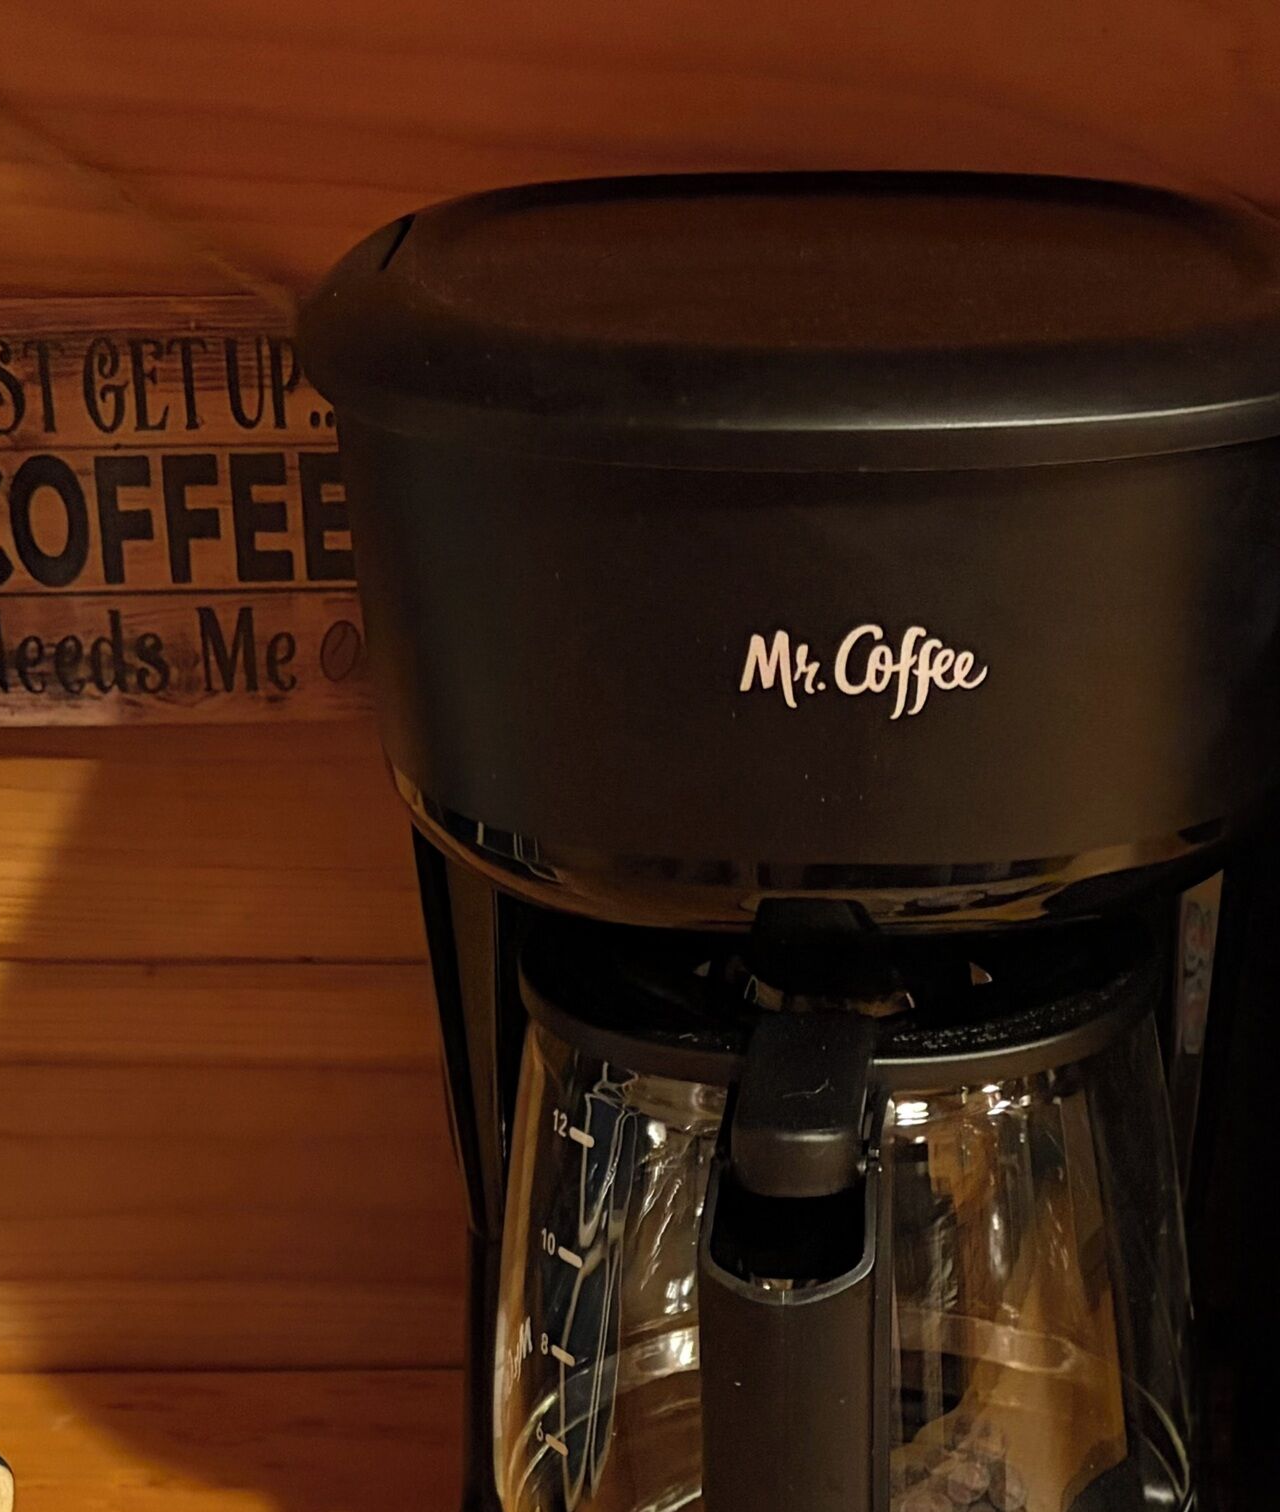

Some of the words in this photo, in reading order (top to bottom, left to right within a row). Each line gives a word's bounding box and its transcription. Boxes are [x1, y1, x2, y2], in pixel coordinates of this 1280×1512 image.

[84, 338, 209, 433] GET
[196, 607, 297, 694] Me
[740, 630, 826, 708] Mr.
[834, 624, 988, 720] Coffee
[552, 1109, 567, 1137] 12
[542, 1229, 556, 1256] 10
[540, 1334, 549, 1355] 8
[535, 1422, 544, 1441] 6
